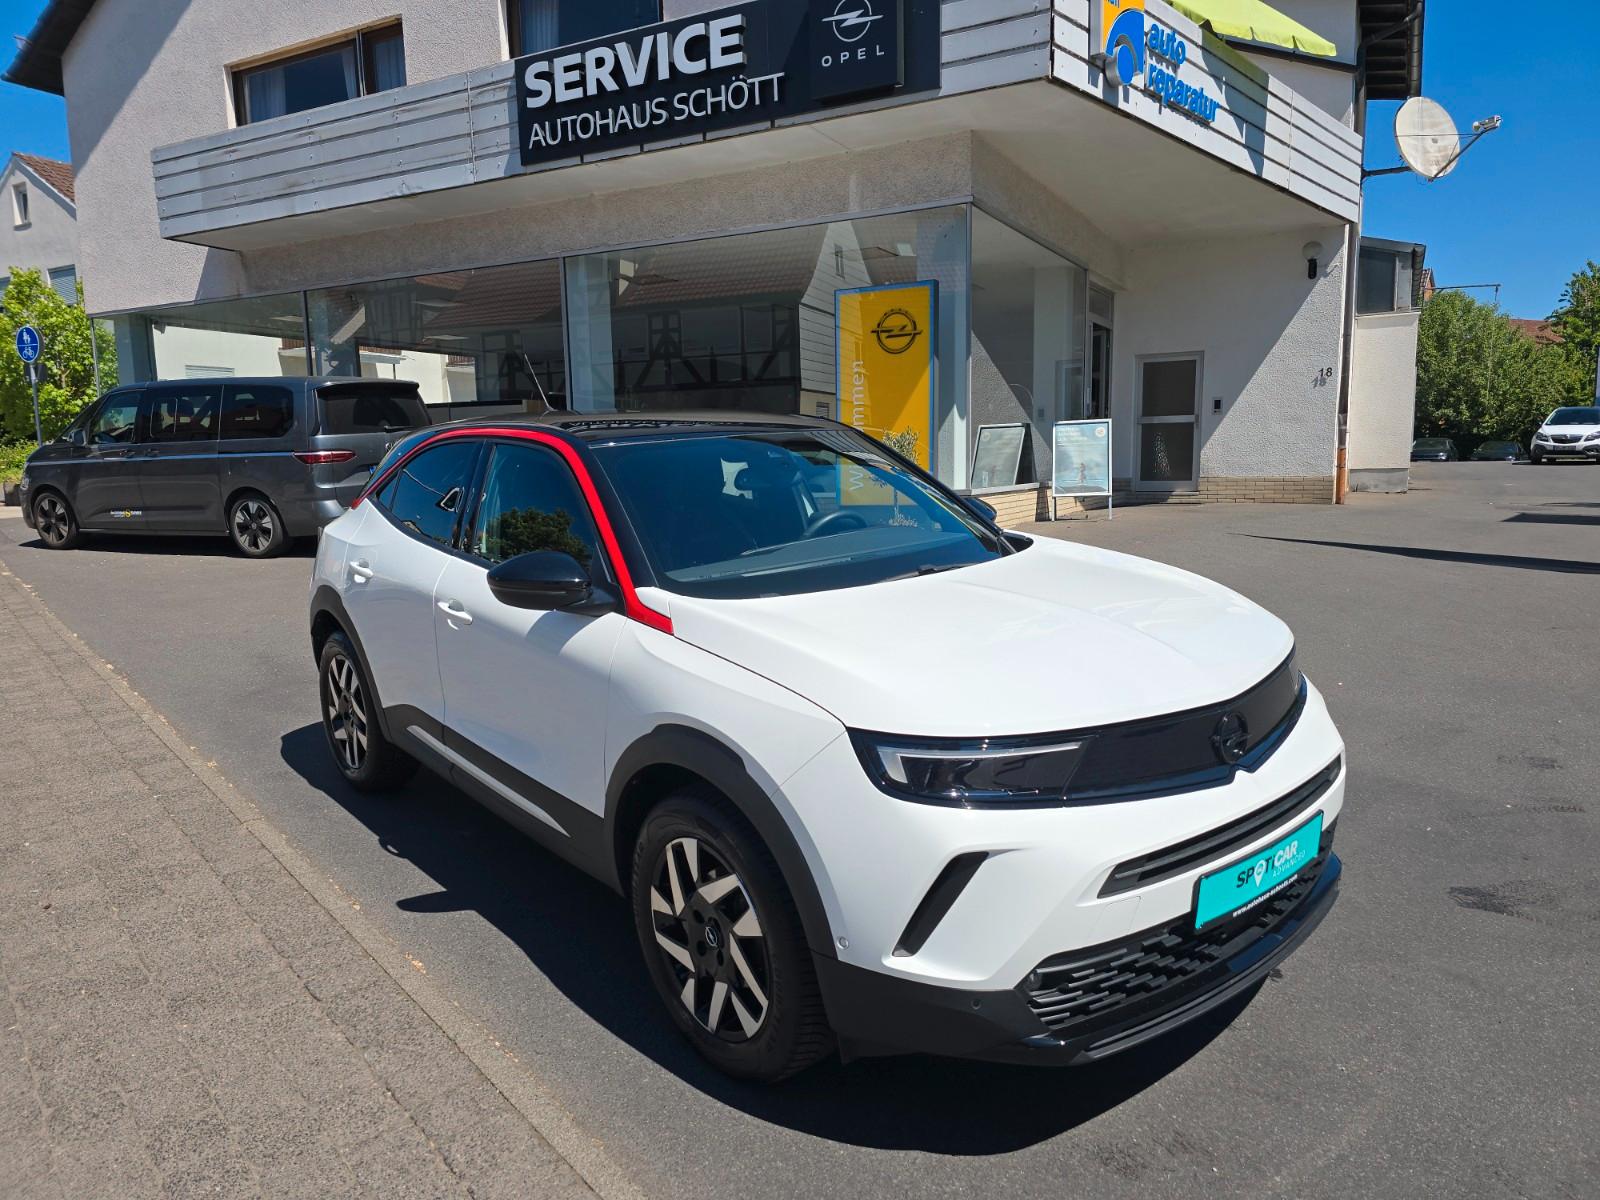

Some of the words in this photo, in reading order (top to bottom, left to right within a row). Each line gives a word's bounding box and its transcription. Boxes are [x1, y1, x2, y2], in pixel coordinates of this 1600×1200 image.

[524, 14, 745, 108] SERVICE
[821, 44, 885, 67] OPEL
[1147, 23, 1186, 65] auto
[528, 97, 669, 149] AUTOHAUS
[673, 72, 785, 121] SCHÖTT
[1148, 64, 1221, 122] reparatur
[1317, 367, 1333, 378] 18
